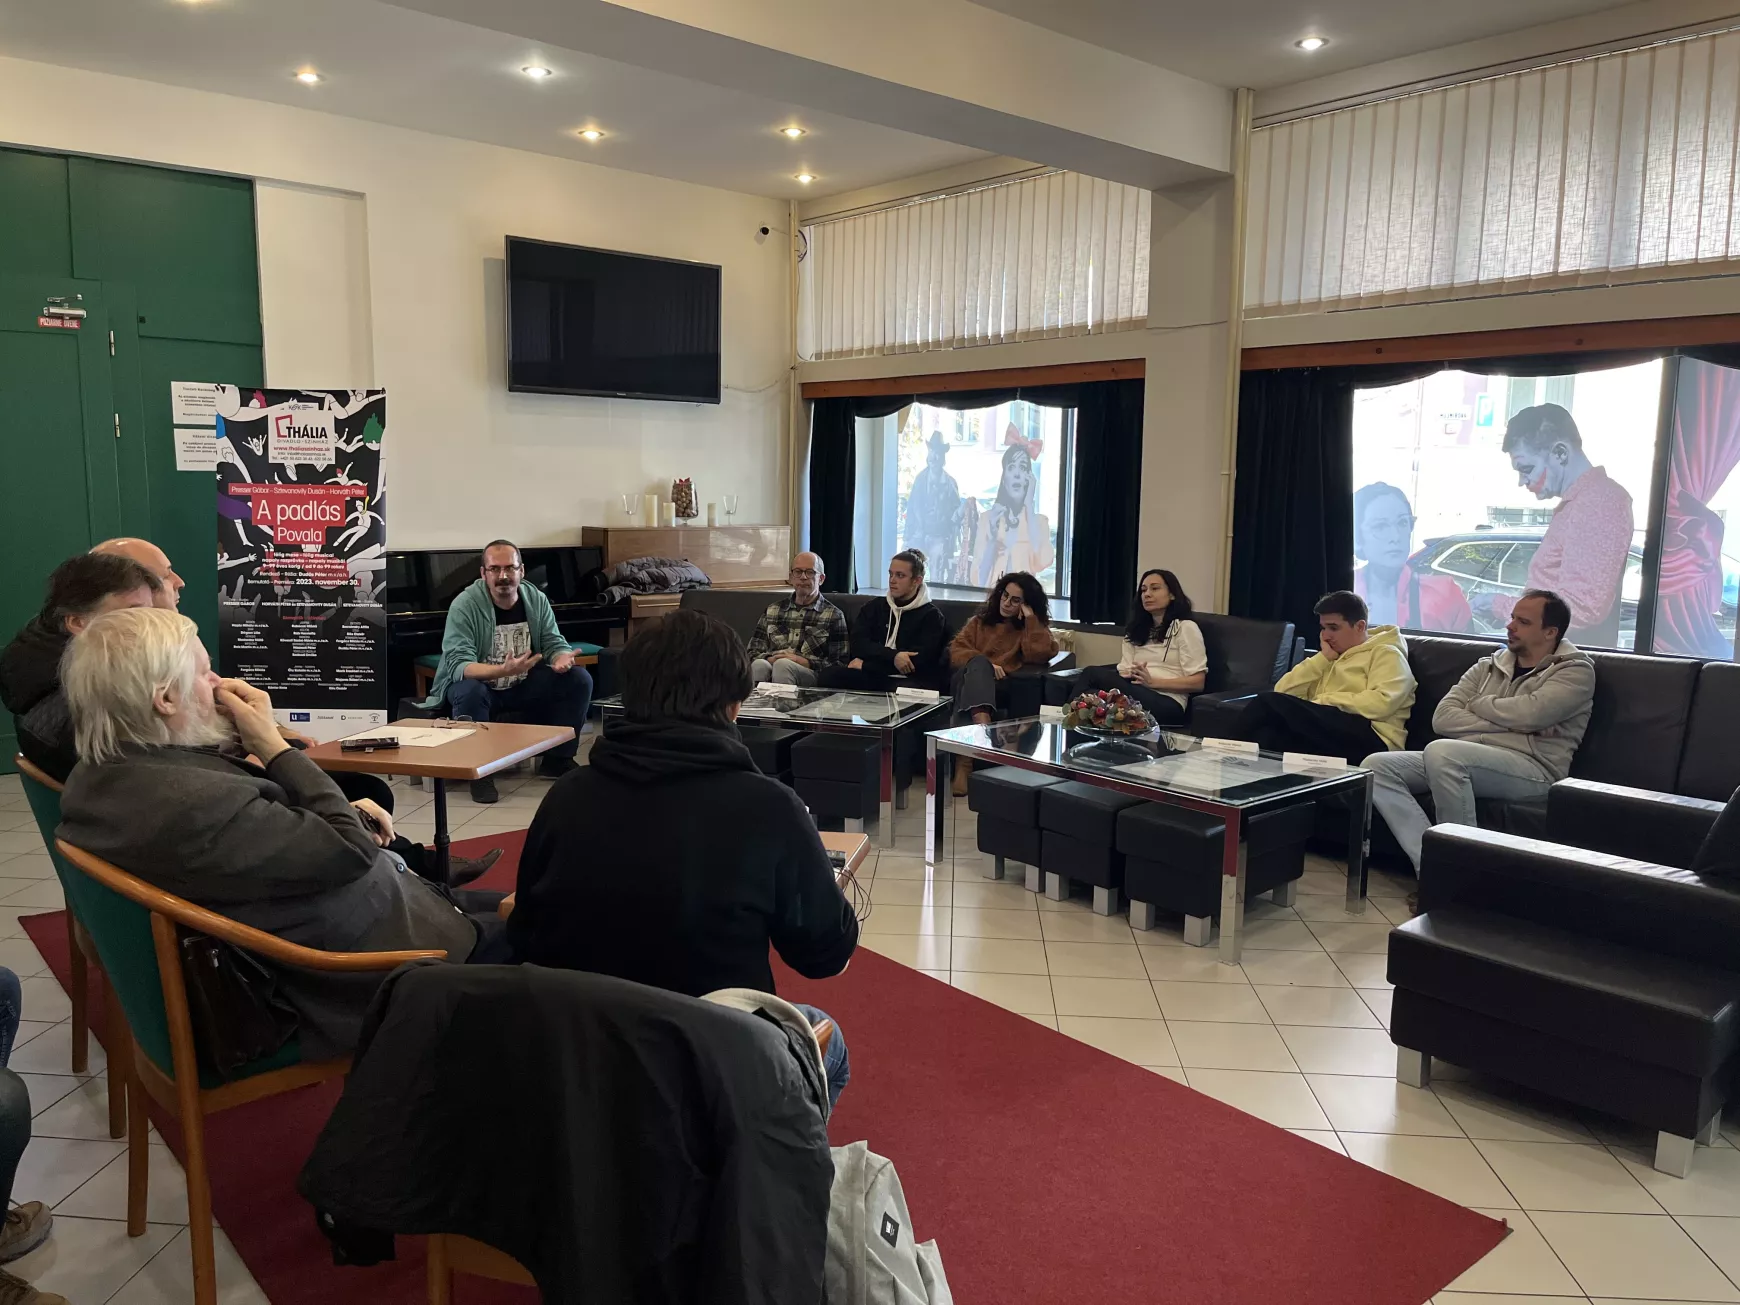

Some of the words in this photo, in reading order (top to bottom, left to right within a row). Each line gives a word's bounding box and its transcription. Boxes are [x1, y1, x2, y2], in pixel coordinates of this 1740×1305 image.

[1480, 398, 1492, 424] P
[286, 424, 328, 438] THÁLIA
[257, 500, 271, 520] A
[277, 500, 340, 525] padlás
[278, 528, 322, 542] Povala
